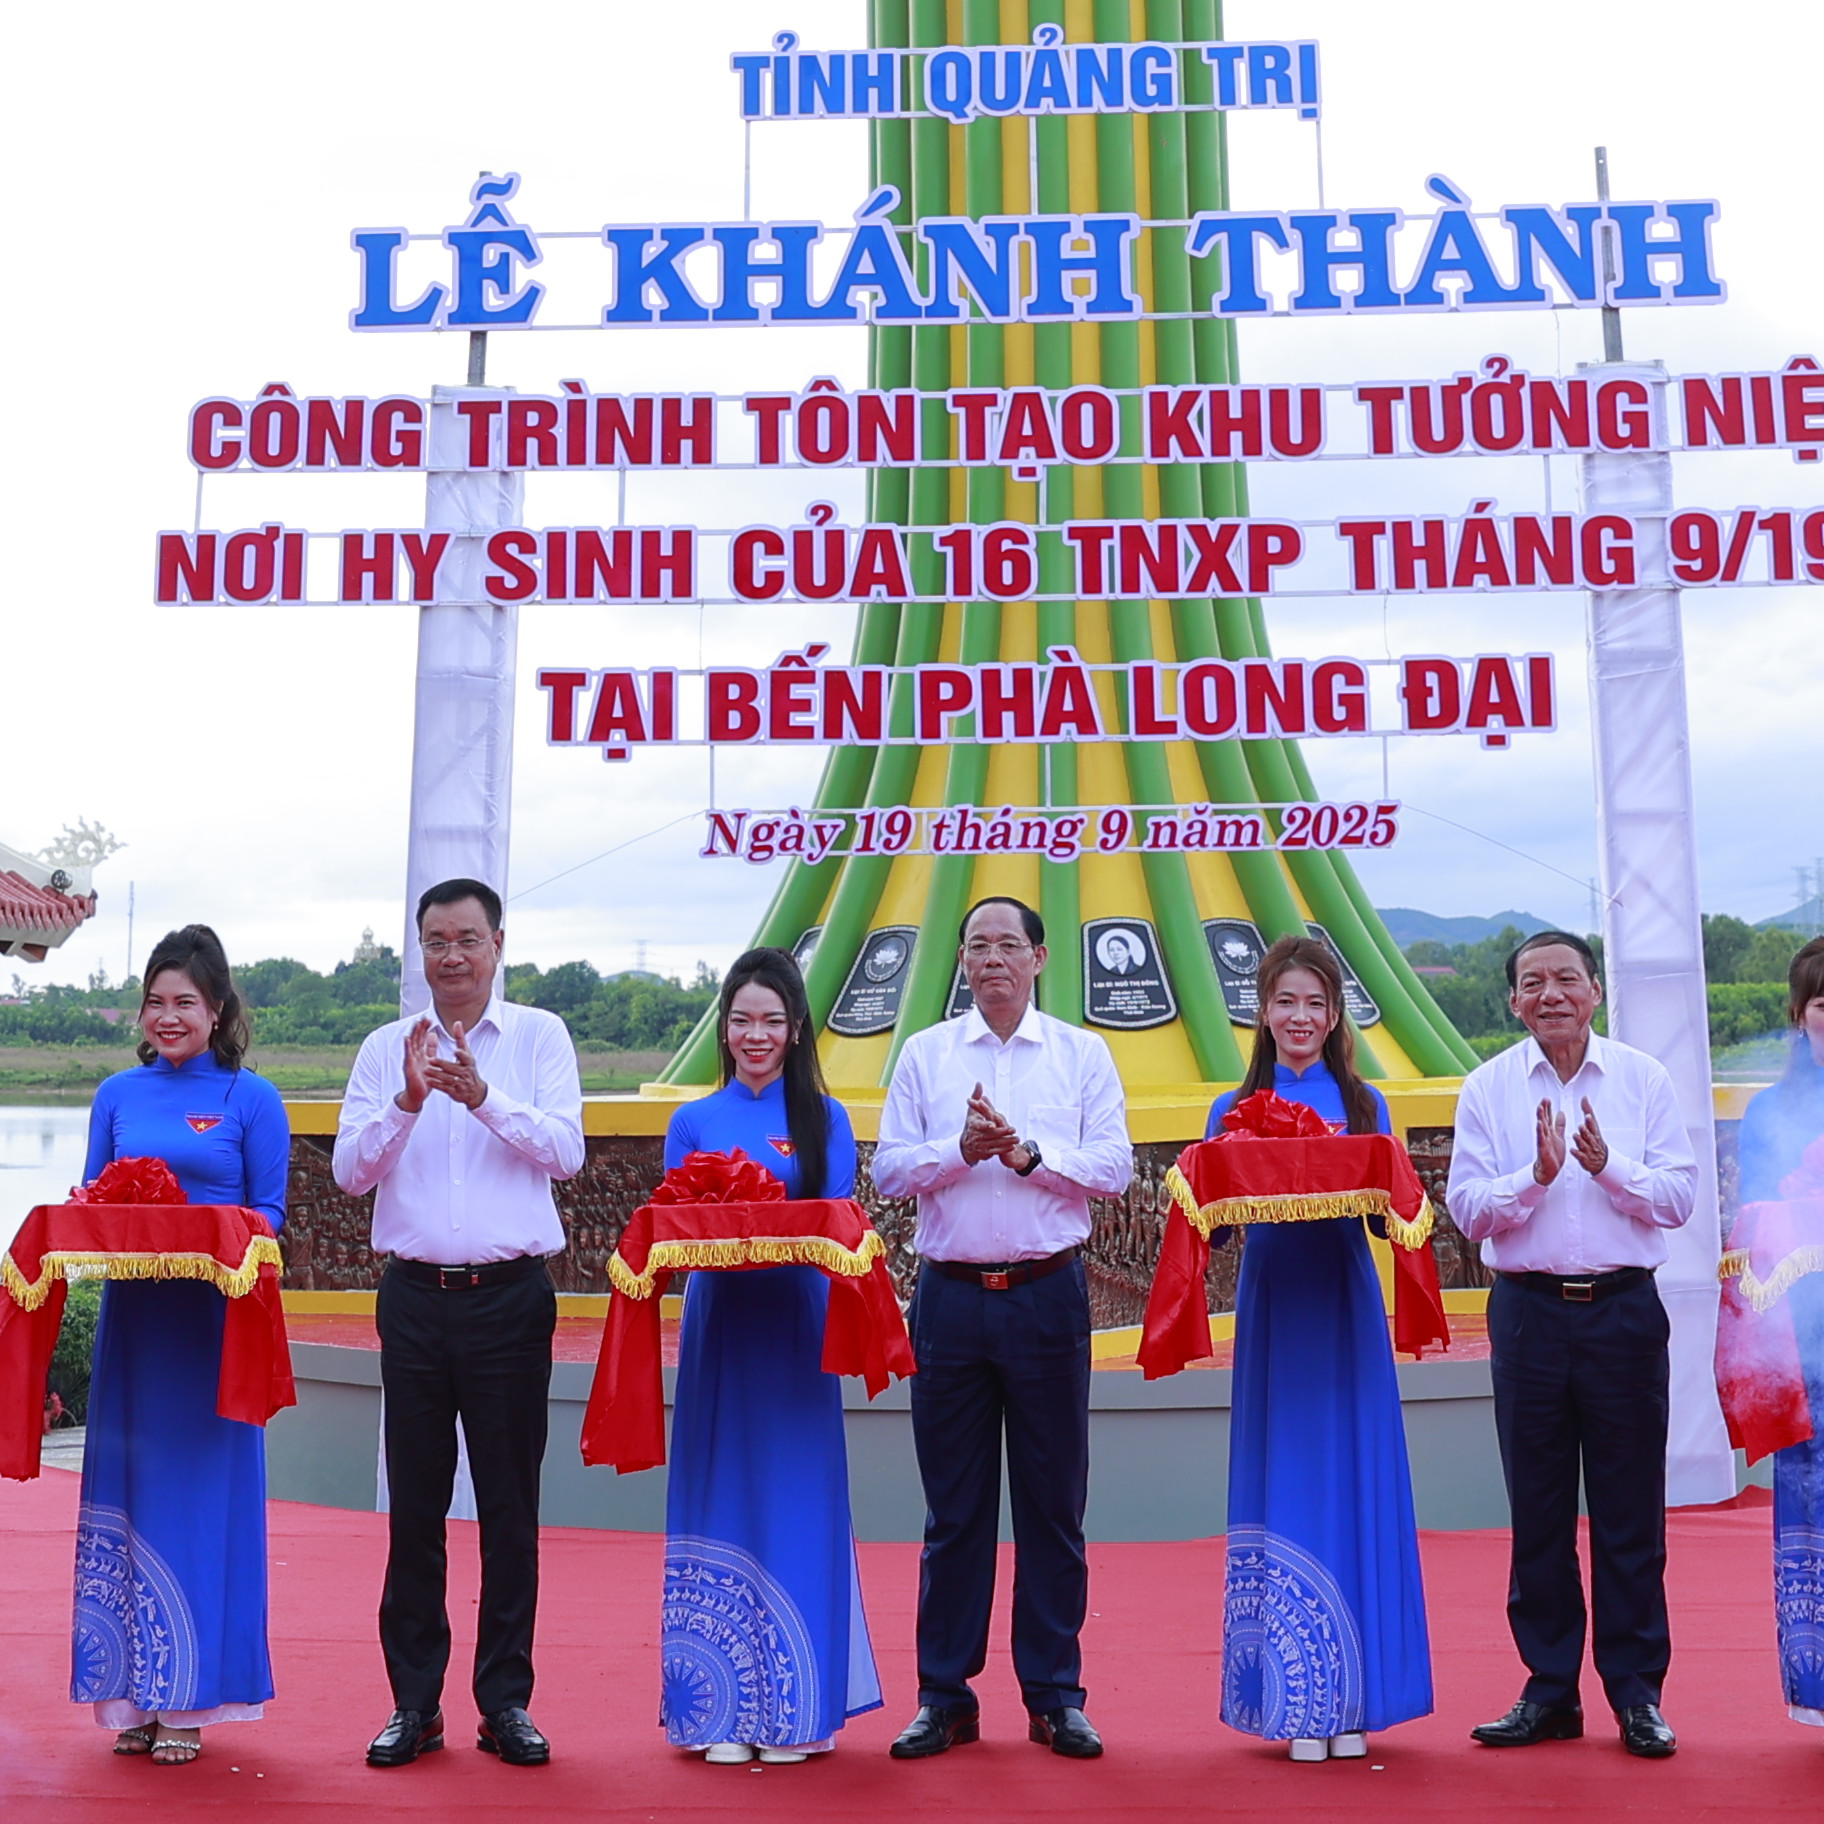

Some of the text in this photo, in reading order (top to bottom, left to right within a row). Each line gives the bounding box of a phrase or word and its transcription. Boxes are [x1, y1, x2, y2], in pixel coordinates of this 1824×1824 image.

[734, 27, 1317, 118] TỈNH QUẢNG TRỊ
[355, 177, 1721, 326] LỄ KHÁNH THÀNH
[194, 385, 420, 467] CÔNG
[461, 383, 711, 466] TRÌNH
[749, 381, 913, 463] TÔN
[954, 392, 1112, 476] TẠO
[1152, 389, 1320, 457] KHU
[1360, 358, 1648, 453] TƯỞNG
[160, 527, 301, 600] NƠI
[345, 534, 448, 600] HY
[487, 531, 691, 600] SINH
[735, 505, 905, 598] CỦA
[942, 529, 1030, 596] 16
[1070, 525, 1300, 593] TNXP
[1341, 503, 1634, 589] THÁNG
[542, 646, 1551, 758] TẠI BẾN PHÀ LONG ĐẠI
[703, 803, 1398, 862] Ngày 19 tháng 9 năm 2025
